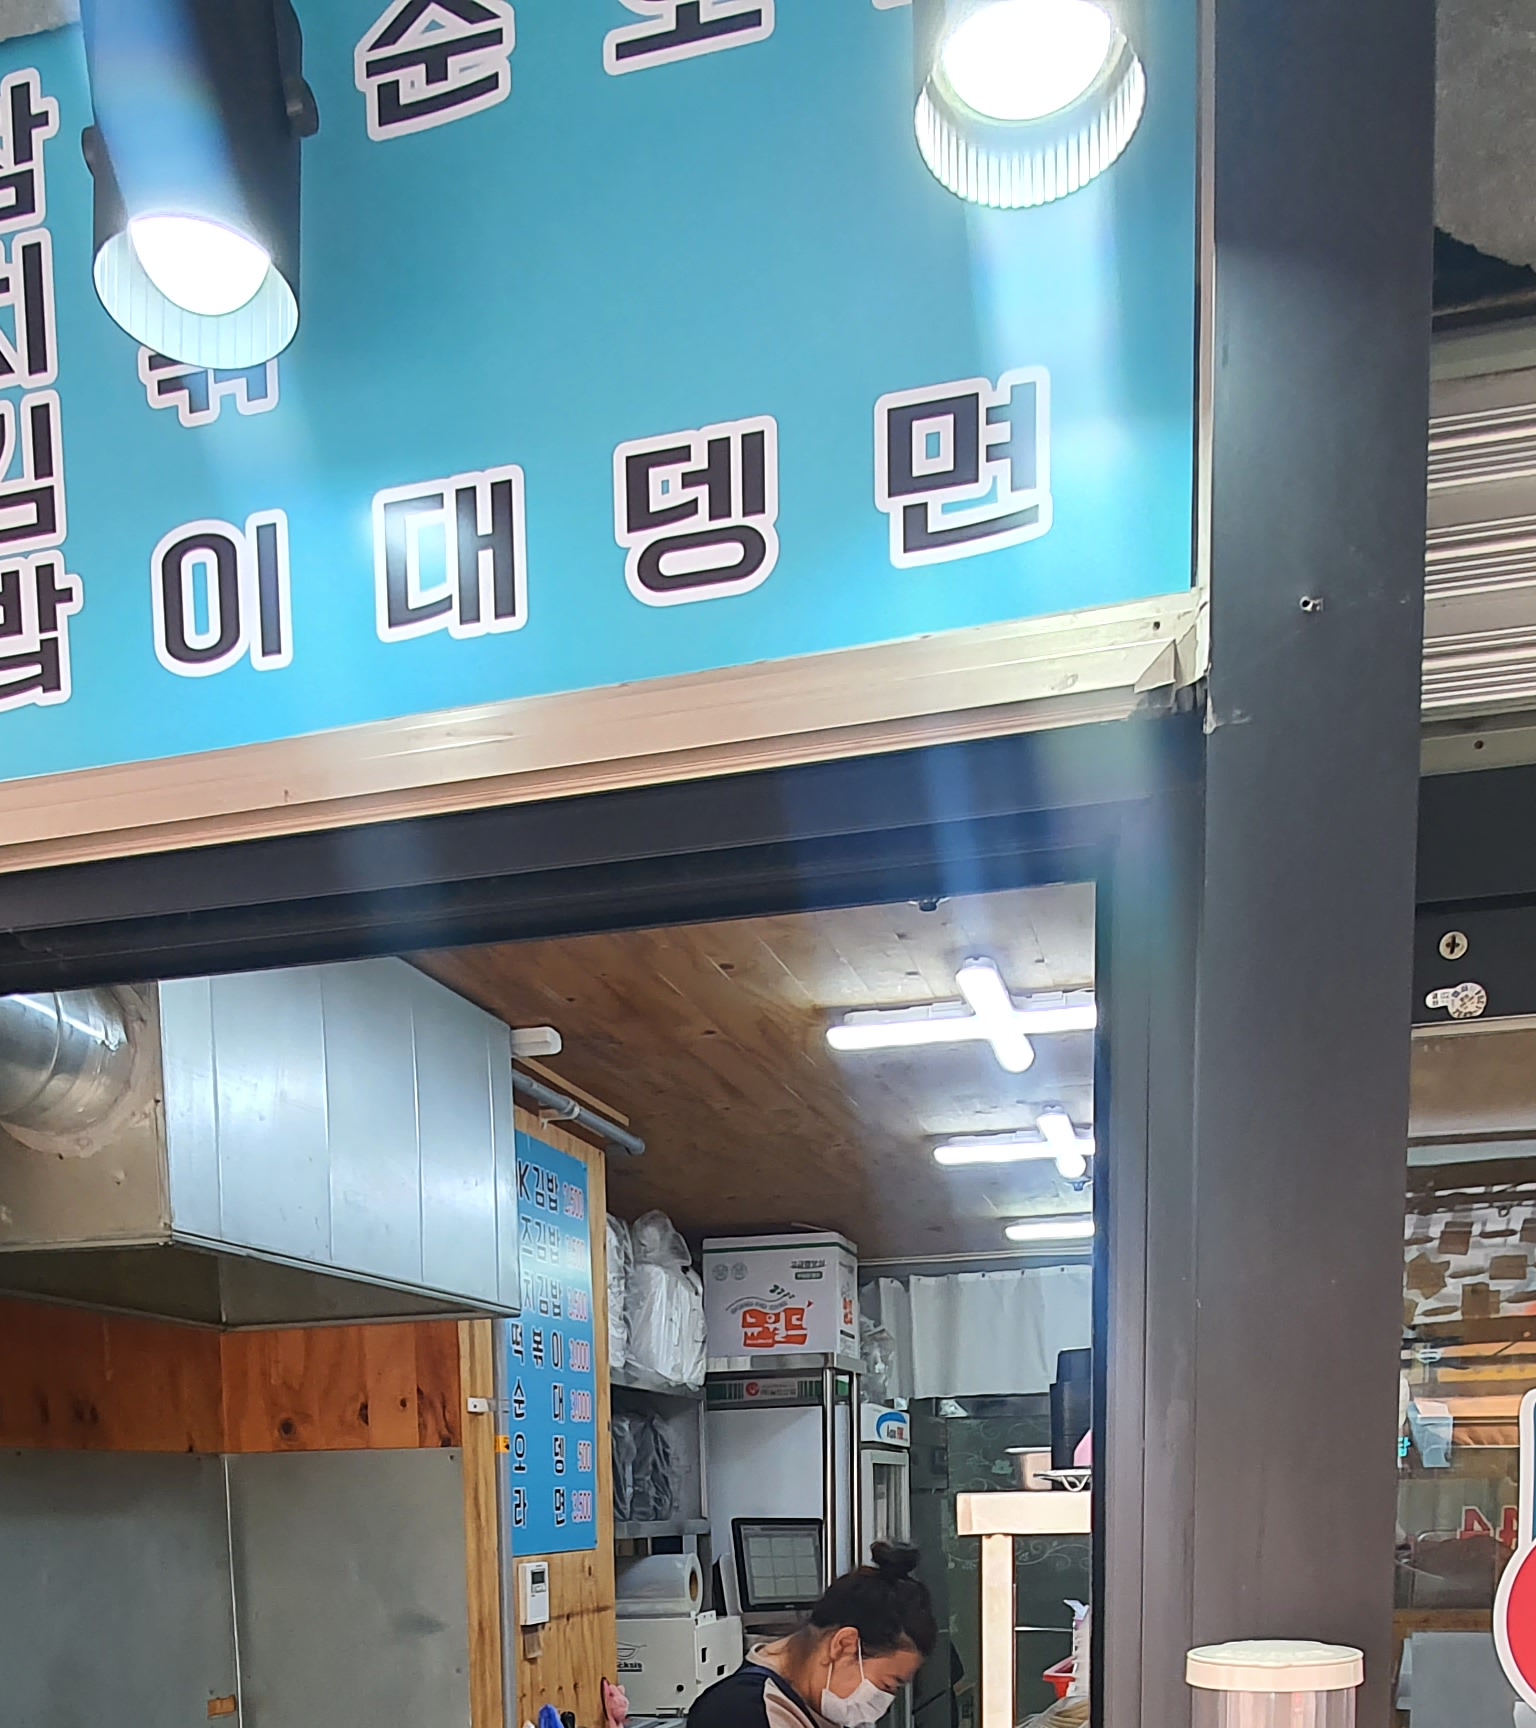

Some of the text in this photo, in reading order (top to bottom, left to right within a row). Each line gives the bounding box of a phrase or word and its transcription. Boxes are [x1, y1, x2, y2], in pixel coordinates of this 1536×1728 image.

[516, 1160, 560, 1213] K김밥
[520, 1216, 561, 1264] 즈김밥
[522, 1271, 562, 1318] 치김밥
[510, 1322, 563, 1370] 떡볶이
[512, 1376, 564, 1422] 순대
[513, 1433, 565, 1475] 오뎅
[514, 1487, 566, 1527] 라면
